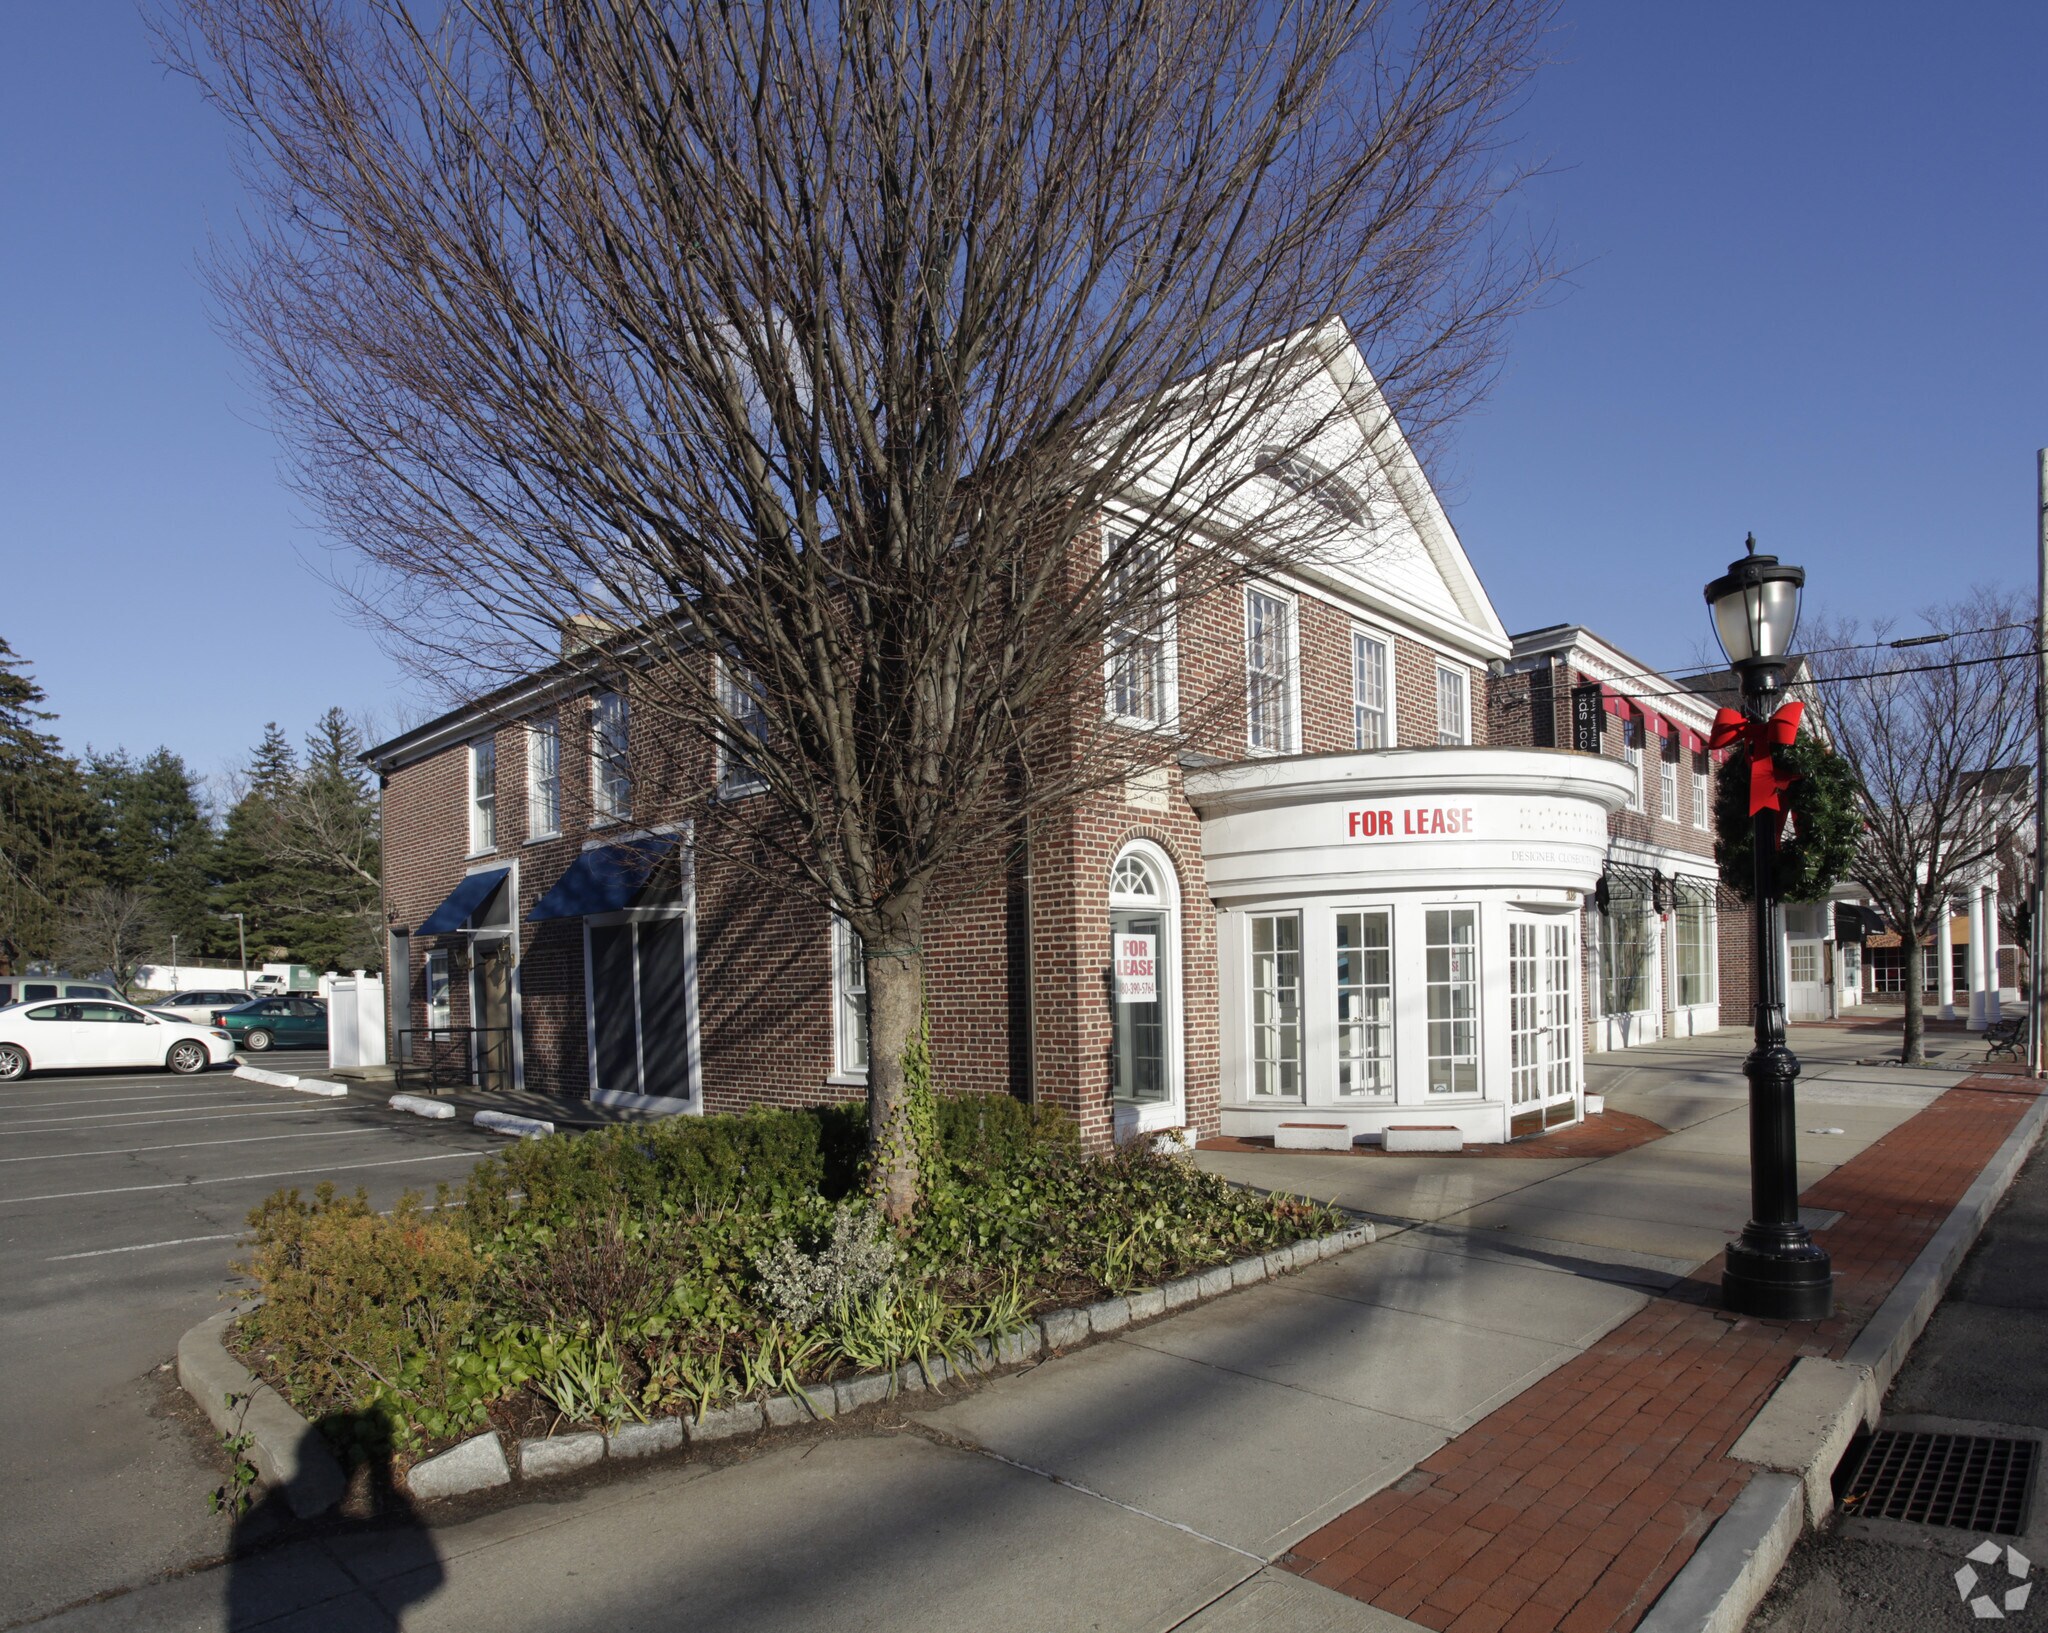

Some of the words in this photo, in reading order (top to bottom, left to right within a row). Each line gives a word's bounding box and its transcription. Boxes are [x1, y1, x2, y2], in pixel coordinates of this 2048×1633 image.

[1579, 724, 1588, 752] oor
[1349, 810, 1394, 837] FOR
[1404, 807, 1473, 835] LEASE
[1511, 850, 1556, 862] DESIGNER
[1123, 940, 1148, 957] FOR
[1116, 959, 1154, 977] LEASE
